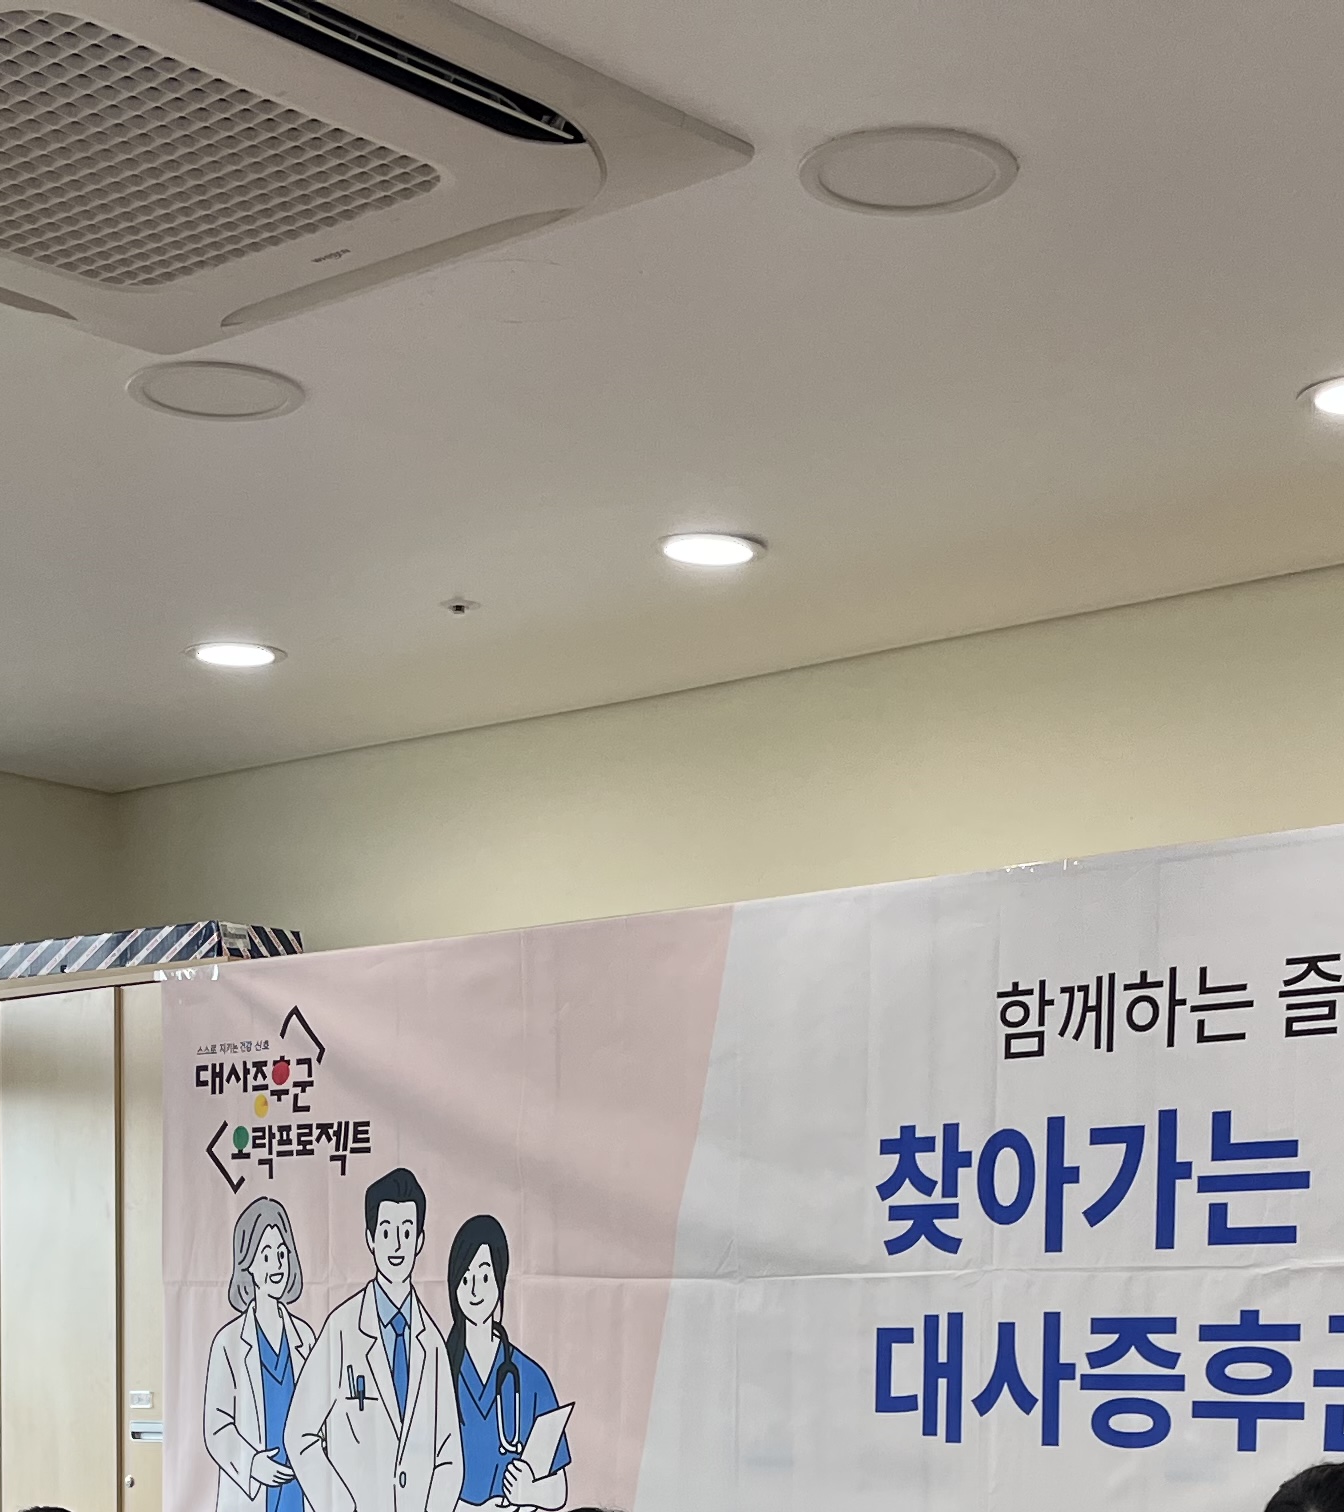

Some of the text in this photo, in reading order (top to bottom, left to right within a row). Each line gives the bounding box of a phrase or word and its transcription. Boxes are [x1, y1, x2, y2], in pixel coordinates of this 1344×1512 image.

[997, 965, 1255, 1060] 함께하는
[195, 1055, 315, 1118] 대사증후군
[877, 1109, 1311, 1255] 찾아가는
